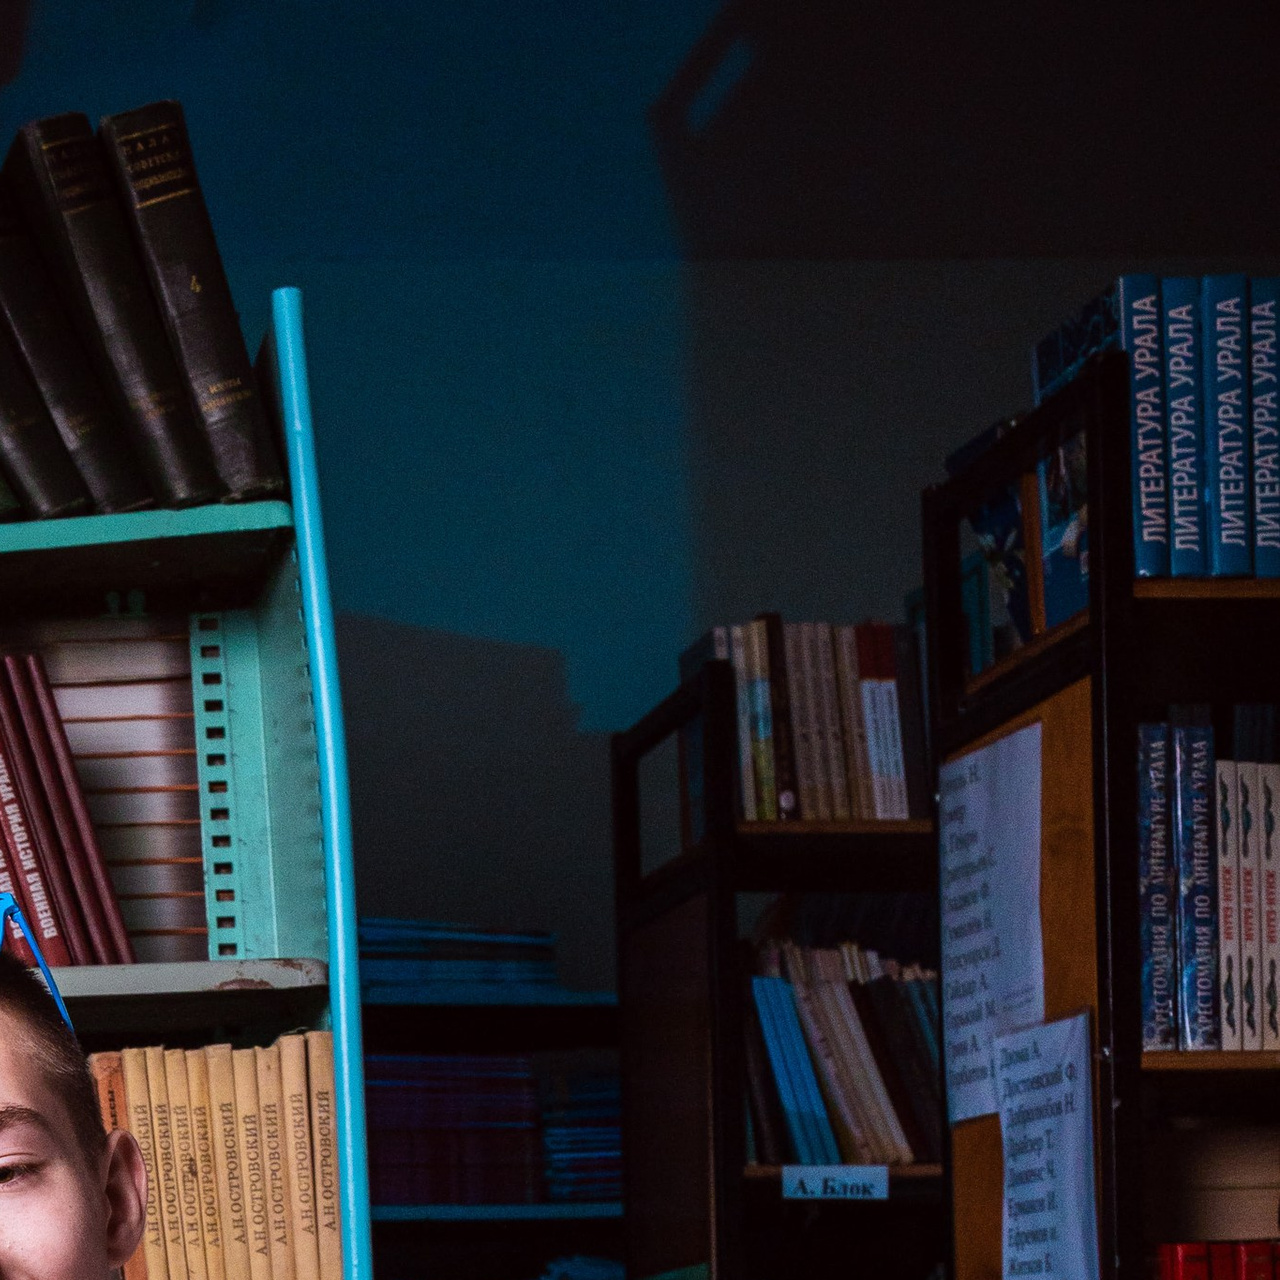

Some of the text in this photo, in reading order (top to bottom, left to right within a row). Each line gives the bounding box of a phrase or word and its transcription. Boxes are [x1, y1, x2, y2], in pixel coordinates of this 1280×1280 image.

[1132, 295, 1167, 544] ЛИТЕРАТУРА УРАЛА
[1168, 304, 1200, 551] ЛИТЕРАТУРА УРАЛА
[1216, 297, 1245, 546] ЛИТЕРАТУРА УРАЛА
[1251, 300, 1280, 548] ЛИТЕРАТУРА УРАЛА
[1191, 741, 1208, 789] УРАЛА
[6, 804, 36, 870] ИСТОРИЯ
[1149, 797, 1168, 885] ЛИТЕРАТУРЕ
[1192, 797, 1211, 887] ЛИТЕРАТУРЕ
[26, 873, 59, 938] ВОЕННАЯ
[1151, 894, 1167, 917] ПО
[1194, 895, 1211, 918] ПО
[793, 1174, 875, 1199] А. Блок
